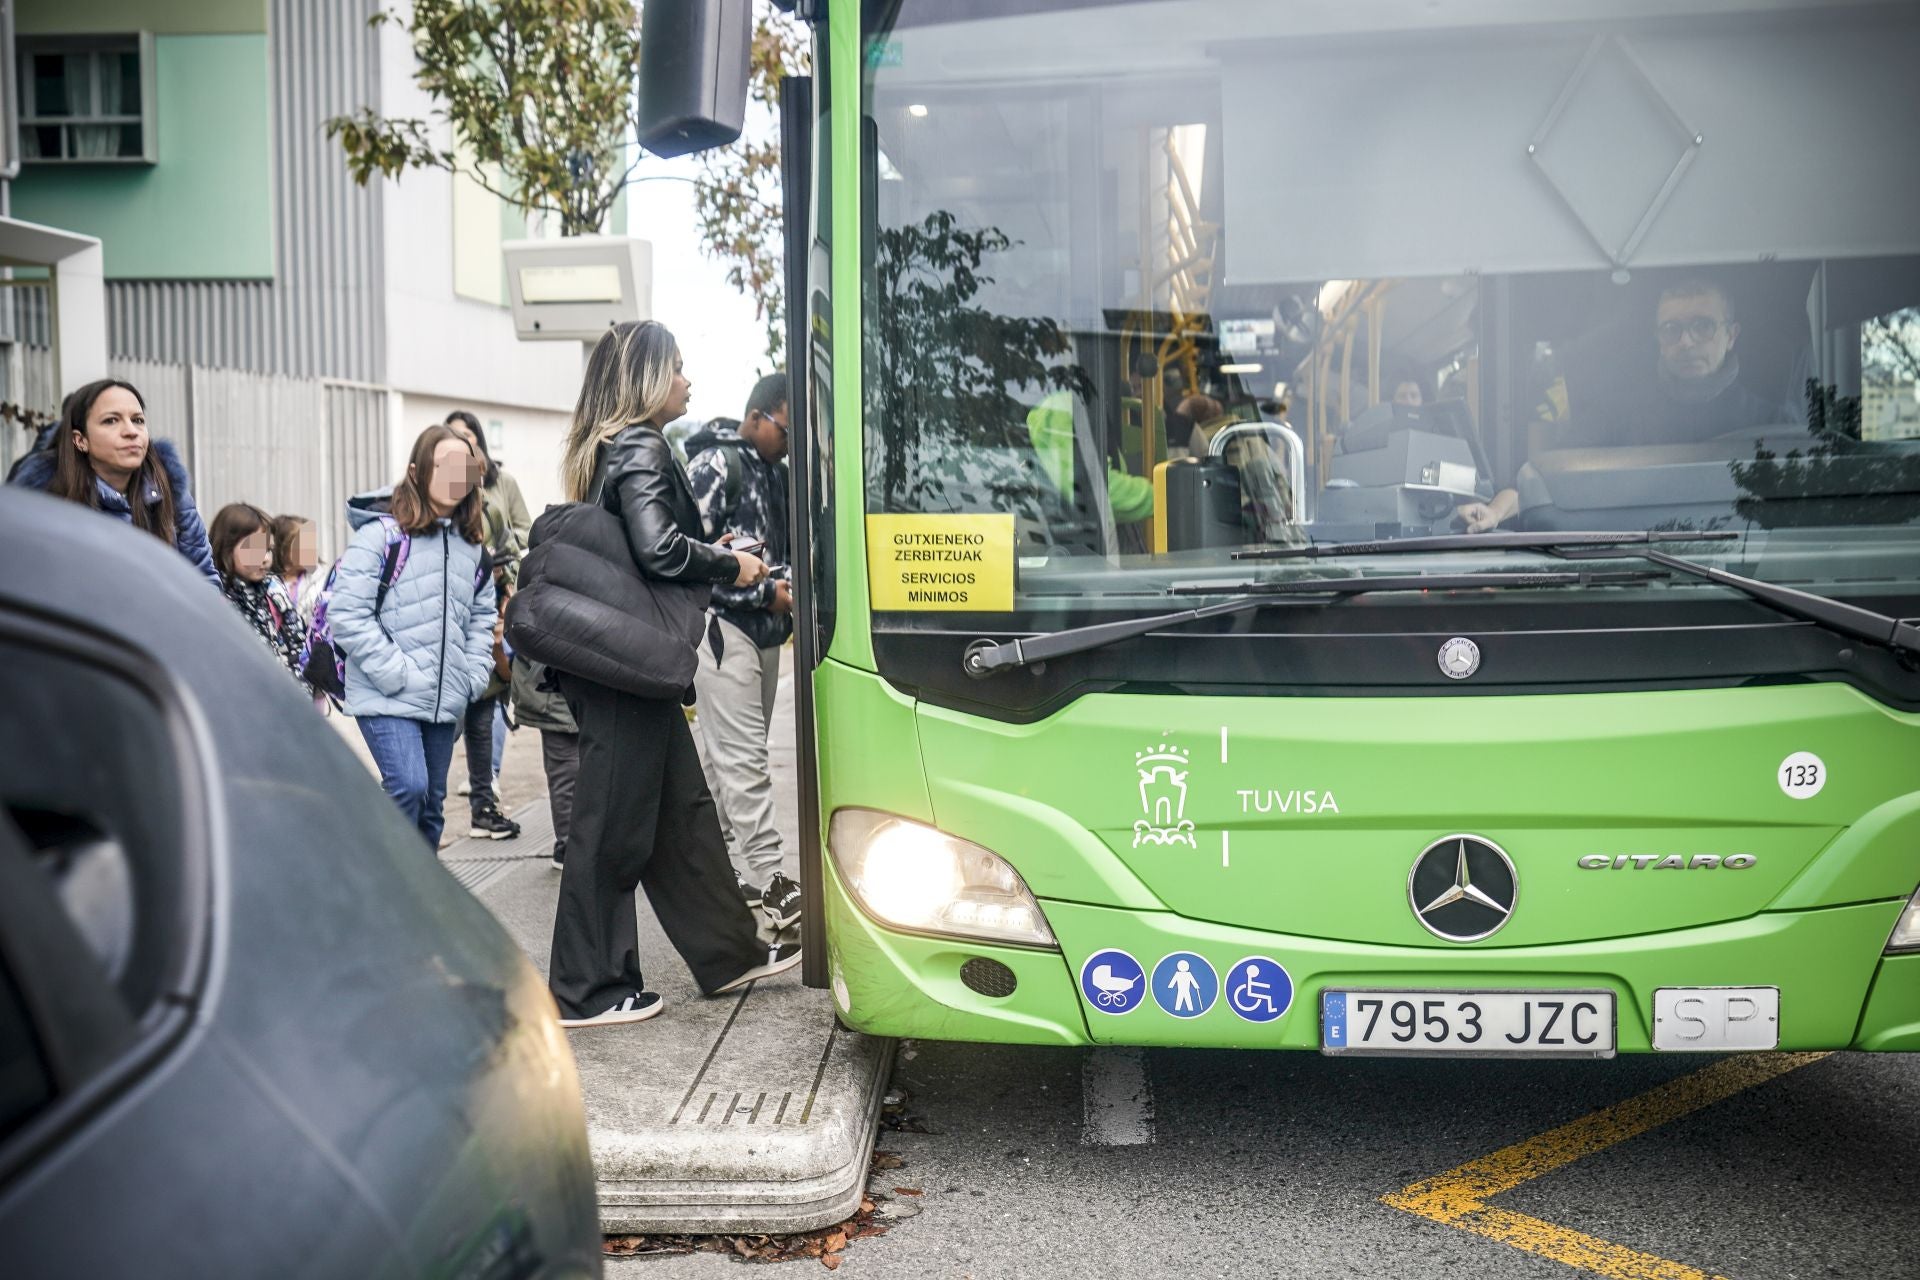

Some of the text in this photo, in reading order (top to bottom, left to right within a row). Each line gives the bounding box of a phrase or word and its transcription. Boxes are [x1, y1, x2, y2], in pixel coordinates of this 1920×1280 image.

[893, 534, 984, 545] GUTXIENEKO
[894, 550, 983, 561] ZERBITZUAK
[901, 572, 976, 584] SERVICIOS
[1784, 765, 1818, 787] 133
[1236, 790, 1340, 813] TUVISA
[1577, 854, 1757, 870] CITARO
[1331, 1000, 1598, 1044] E 7953 JZC
[1674, 997, 1760, 1041] SP
